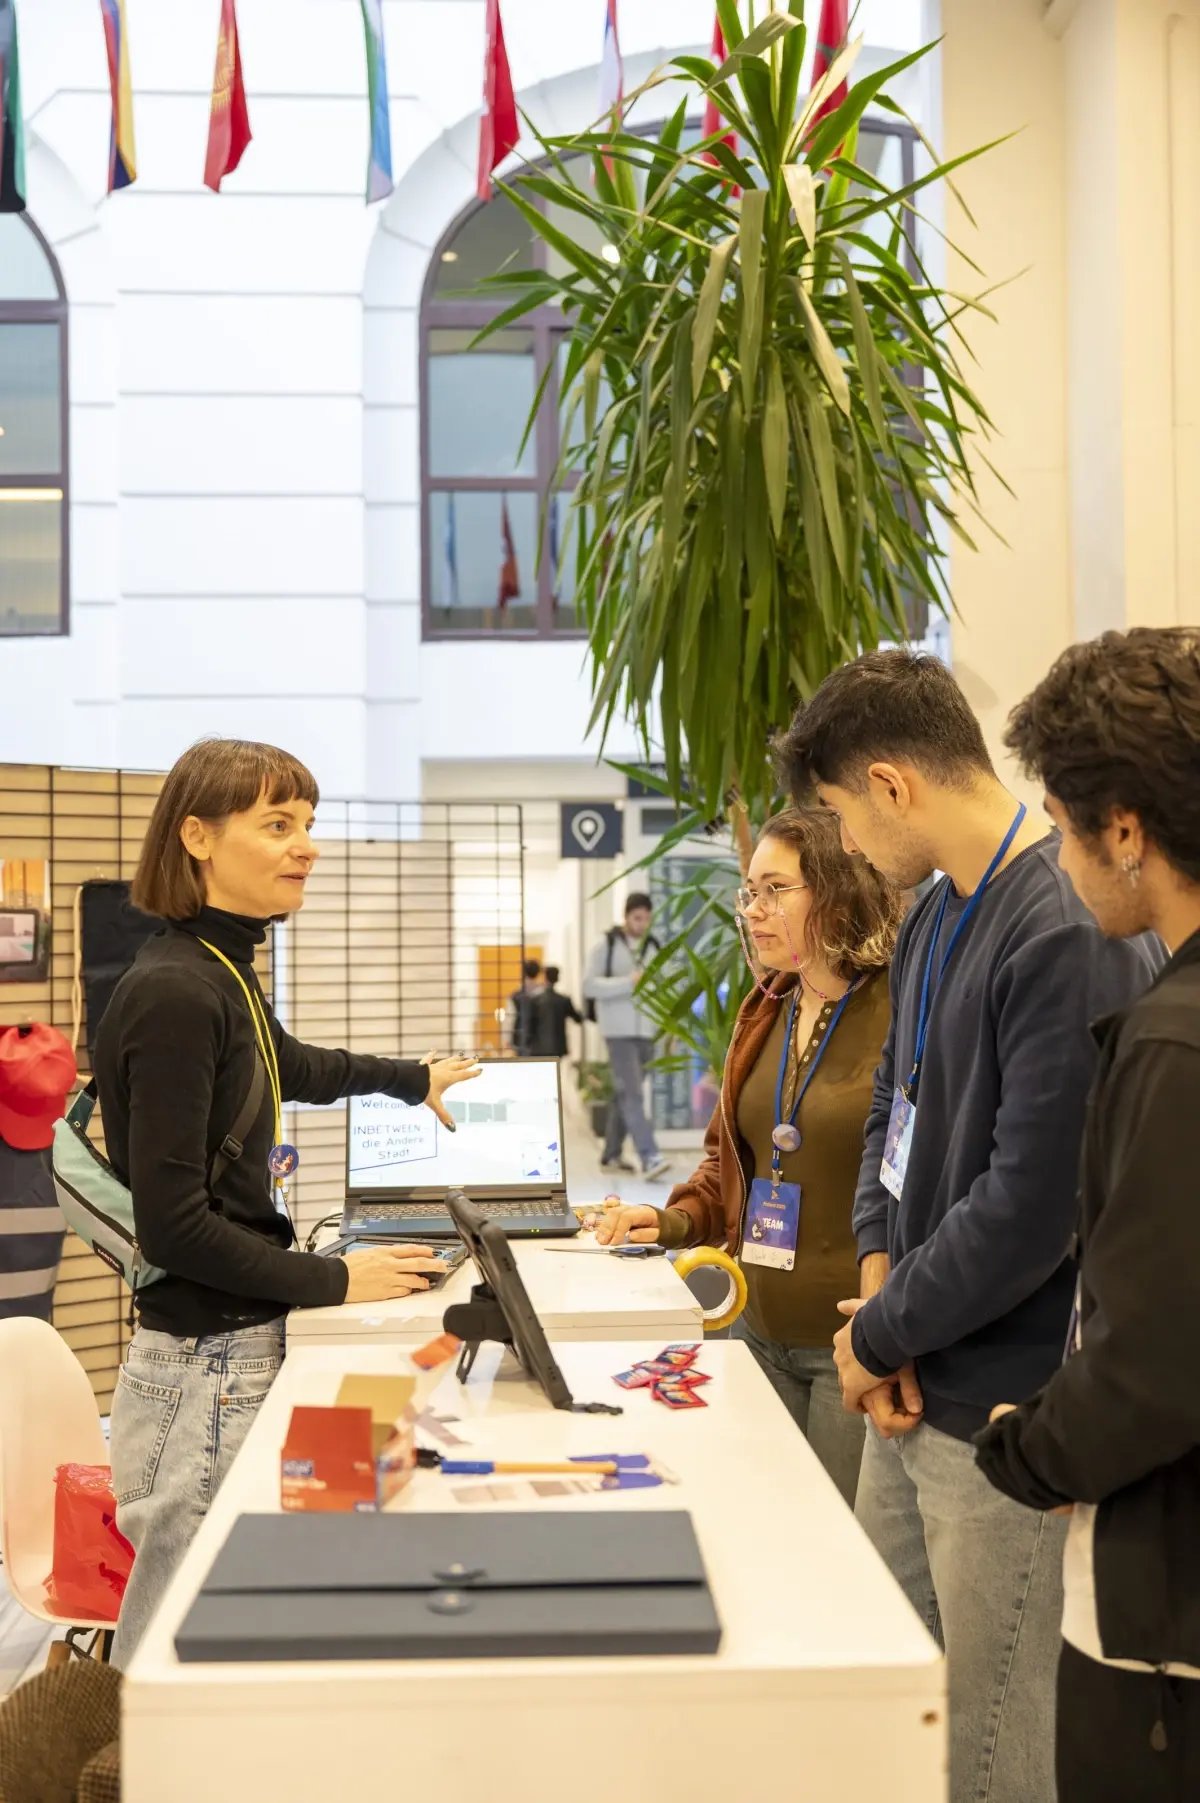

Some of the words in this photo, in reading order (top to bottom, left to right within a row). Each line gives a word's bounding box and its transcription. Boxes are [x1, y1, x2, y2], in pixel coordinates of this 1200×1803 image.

[353, 1124, 421, 1135] INBETWEEN
[362, 1139, 381, 1148] die
[386, 1136, 424, 1146] Andere
[378, 1149, 410, 1160] Stadt
[762, 1217, 784, 1231] TEAM
